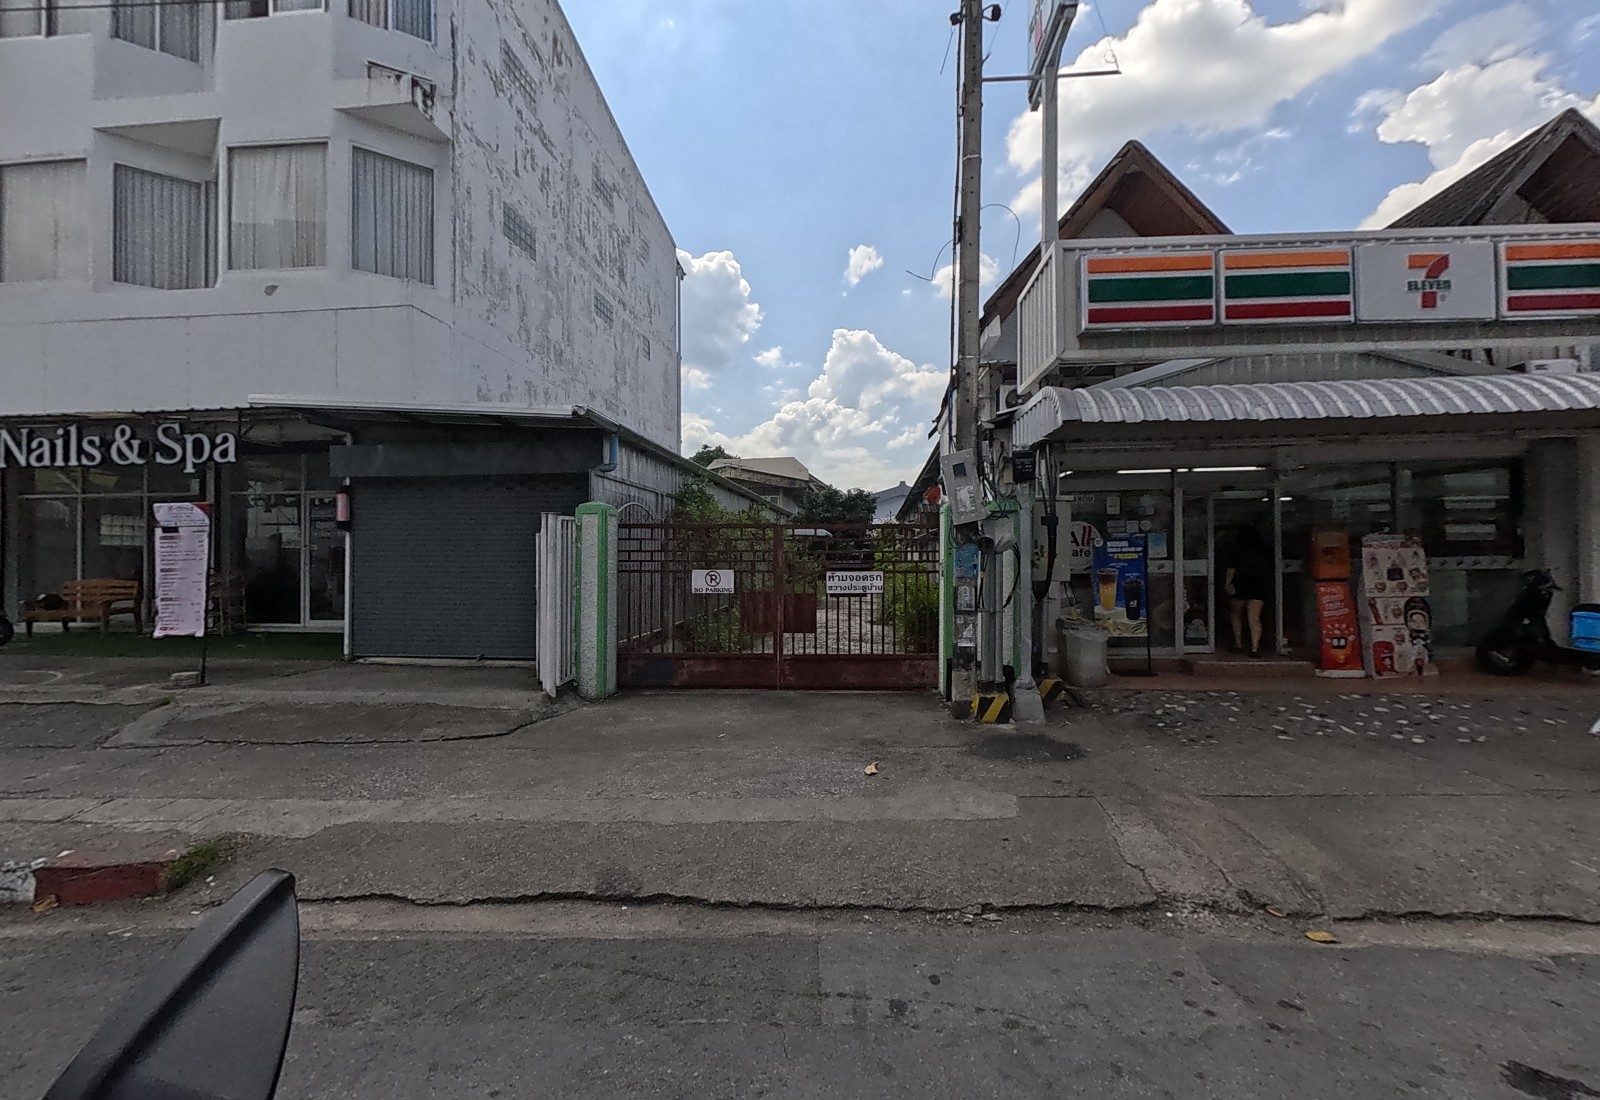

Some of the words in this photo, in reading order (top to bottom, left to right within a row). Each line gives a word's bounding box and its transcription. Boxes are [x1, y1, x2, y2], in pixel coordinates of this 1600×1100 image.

[0, 424, 101, 468] Nails
[110, 424, 147, 465] &
[155, 422, 237, 473] Spa
[1071, 548, 1091, 557] afe
[828, 571, 882, 582] ห้ามจอดรถ
[828, 583, 883, 592] ขวางประตูบ้าน
